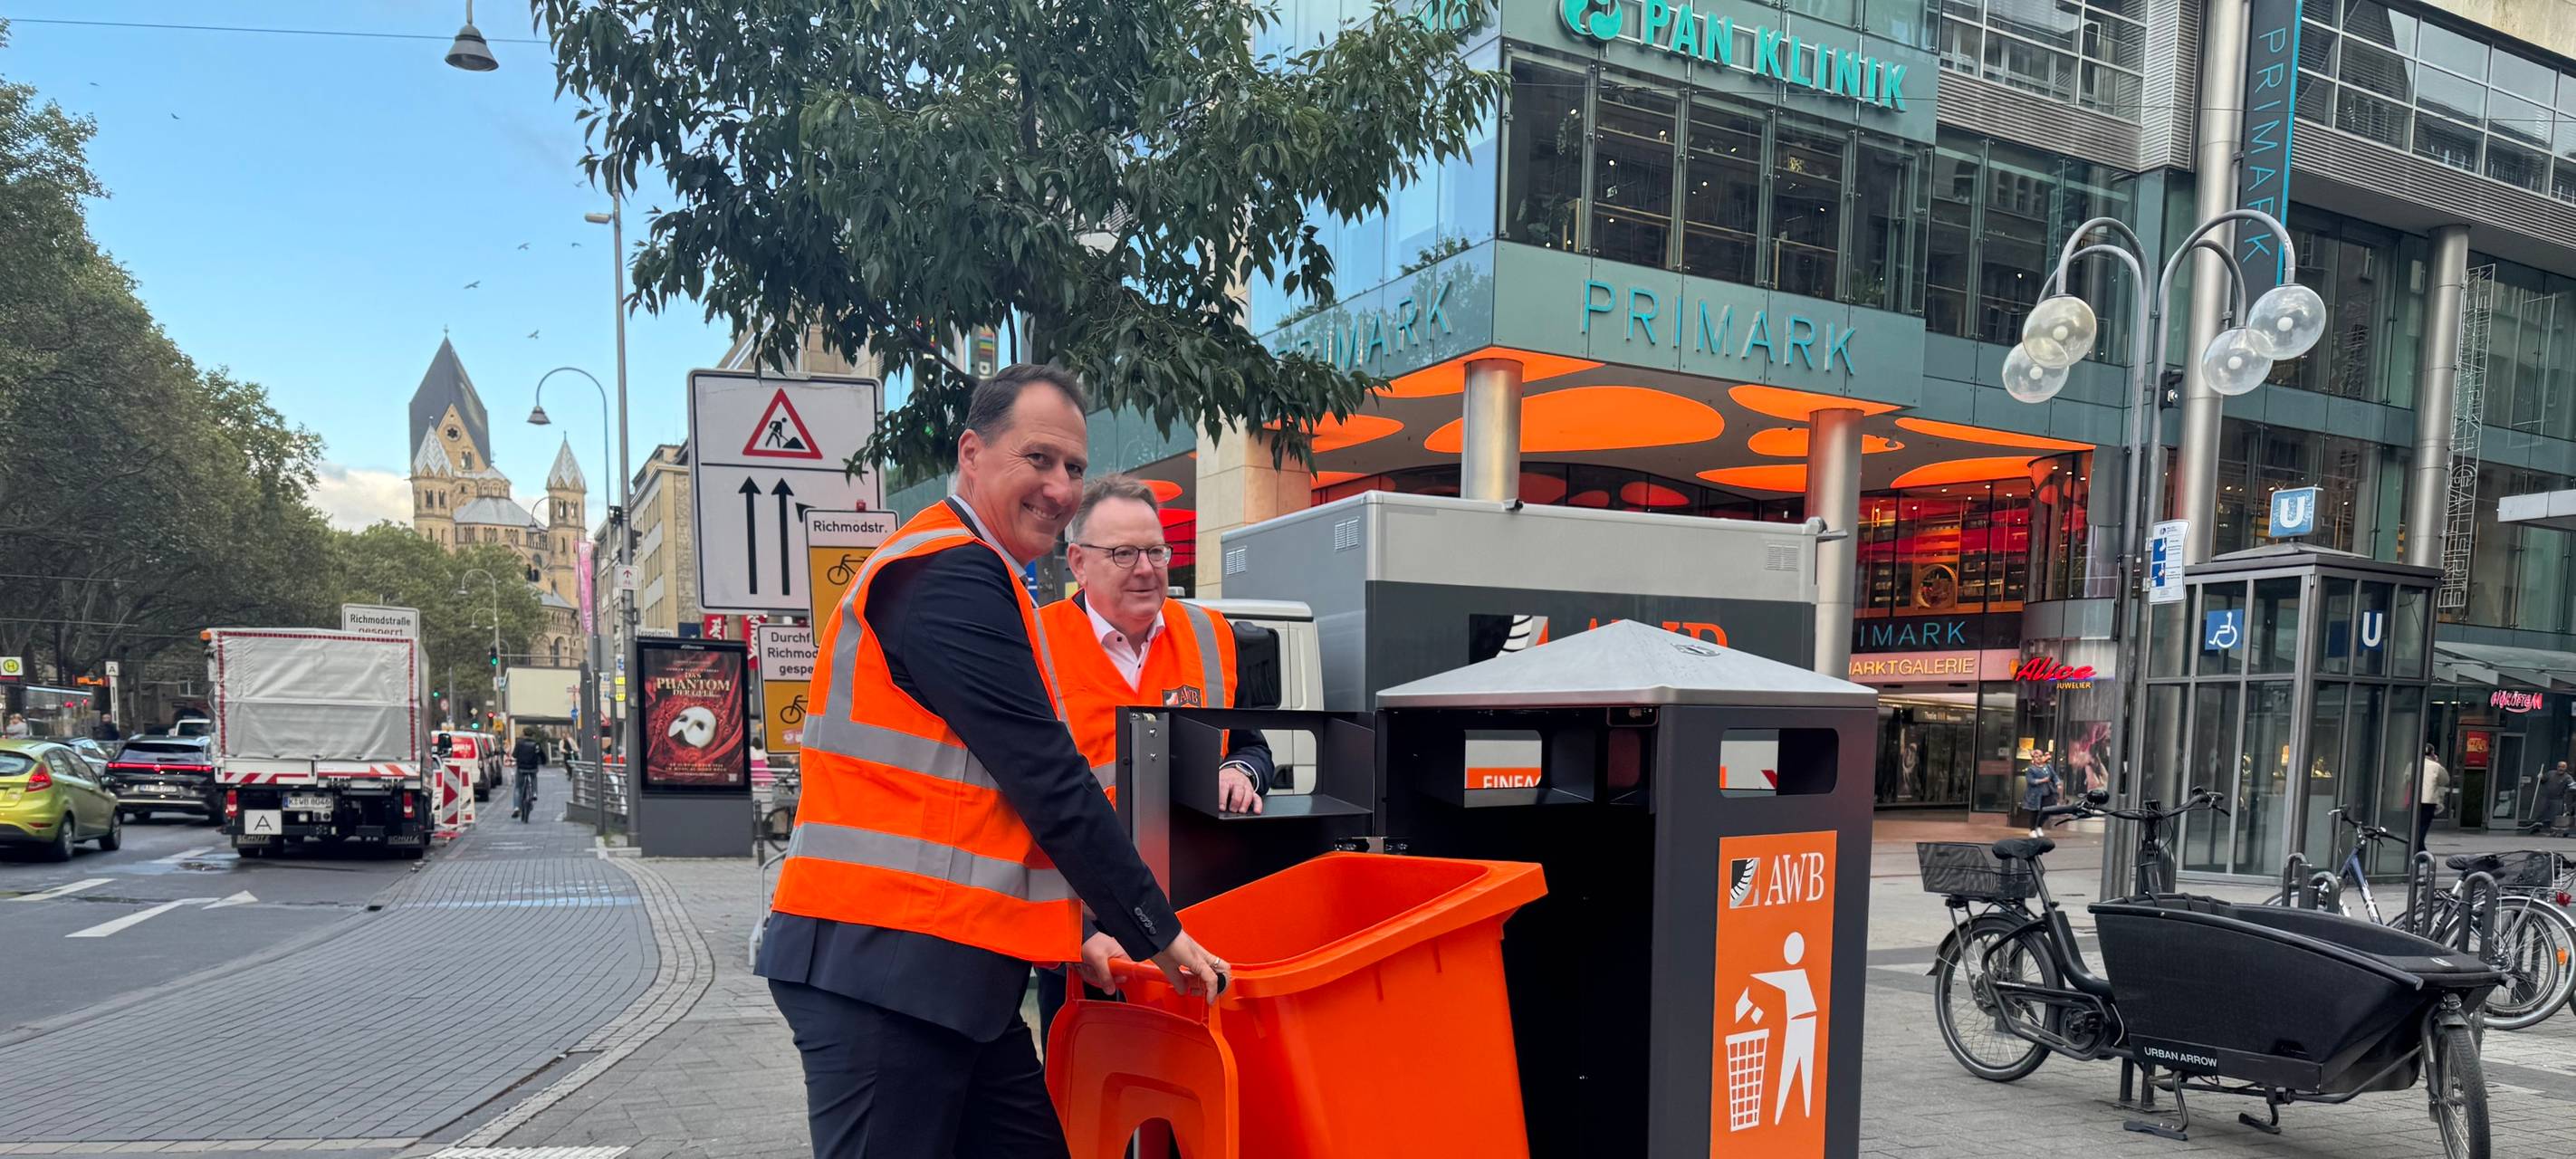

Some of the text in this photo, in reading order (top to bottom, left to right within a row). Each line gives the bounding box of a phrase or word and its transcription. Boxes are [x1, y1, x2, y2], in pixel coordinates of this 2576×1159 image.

[1642, 0, 1908, 112] PAN KLINIK
[2243, 27, 2287, 263] PRIMARK
[1580, 279, 1856, 376] PRIMARK
[2280, 496, 2305, 528] U
[814, 521, 887, 533] Richmodstr.
[2437, 464, 2479, 608] GALERIE
[771, 632, 809, 643] Durchf
[2362, 612, 2383, 647] U
[109, 666, 116, 674] A
[1849, 657, 1975, 675] ARKTGALERIE
[656, 677, 731, 691] PHANTOM
[1181, 688, 1198, 703] AWB
[254, 815, 272, 830] A
[1765, 852, 1824, 905] AWB
[2144, 1047, 2217, 1067] URBAN ARROW
